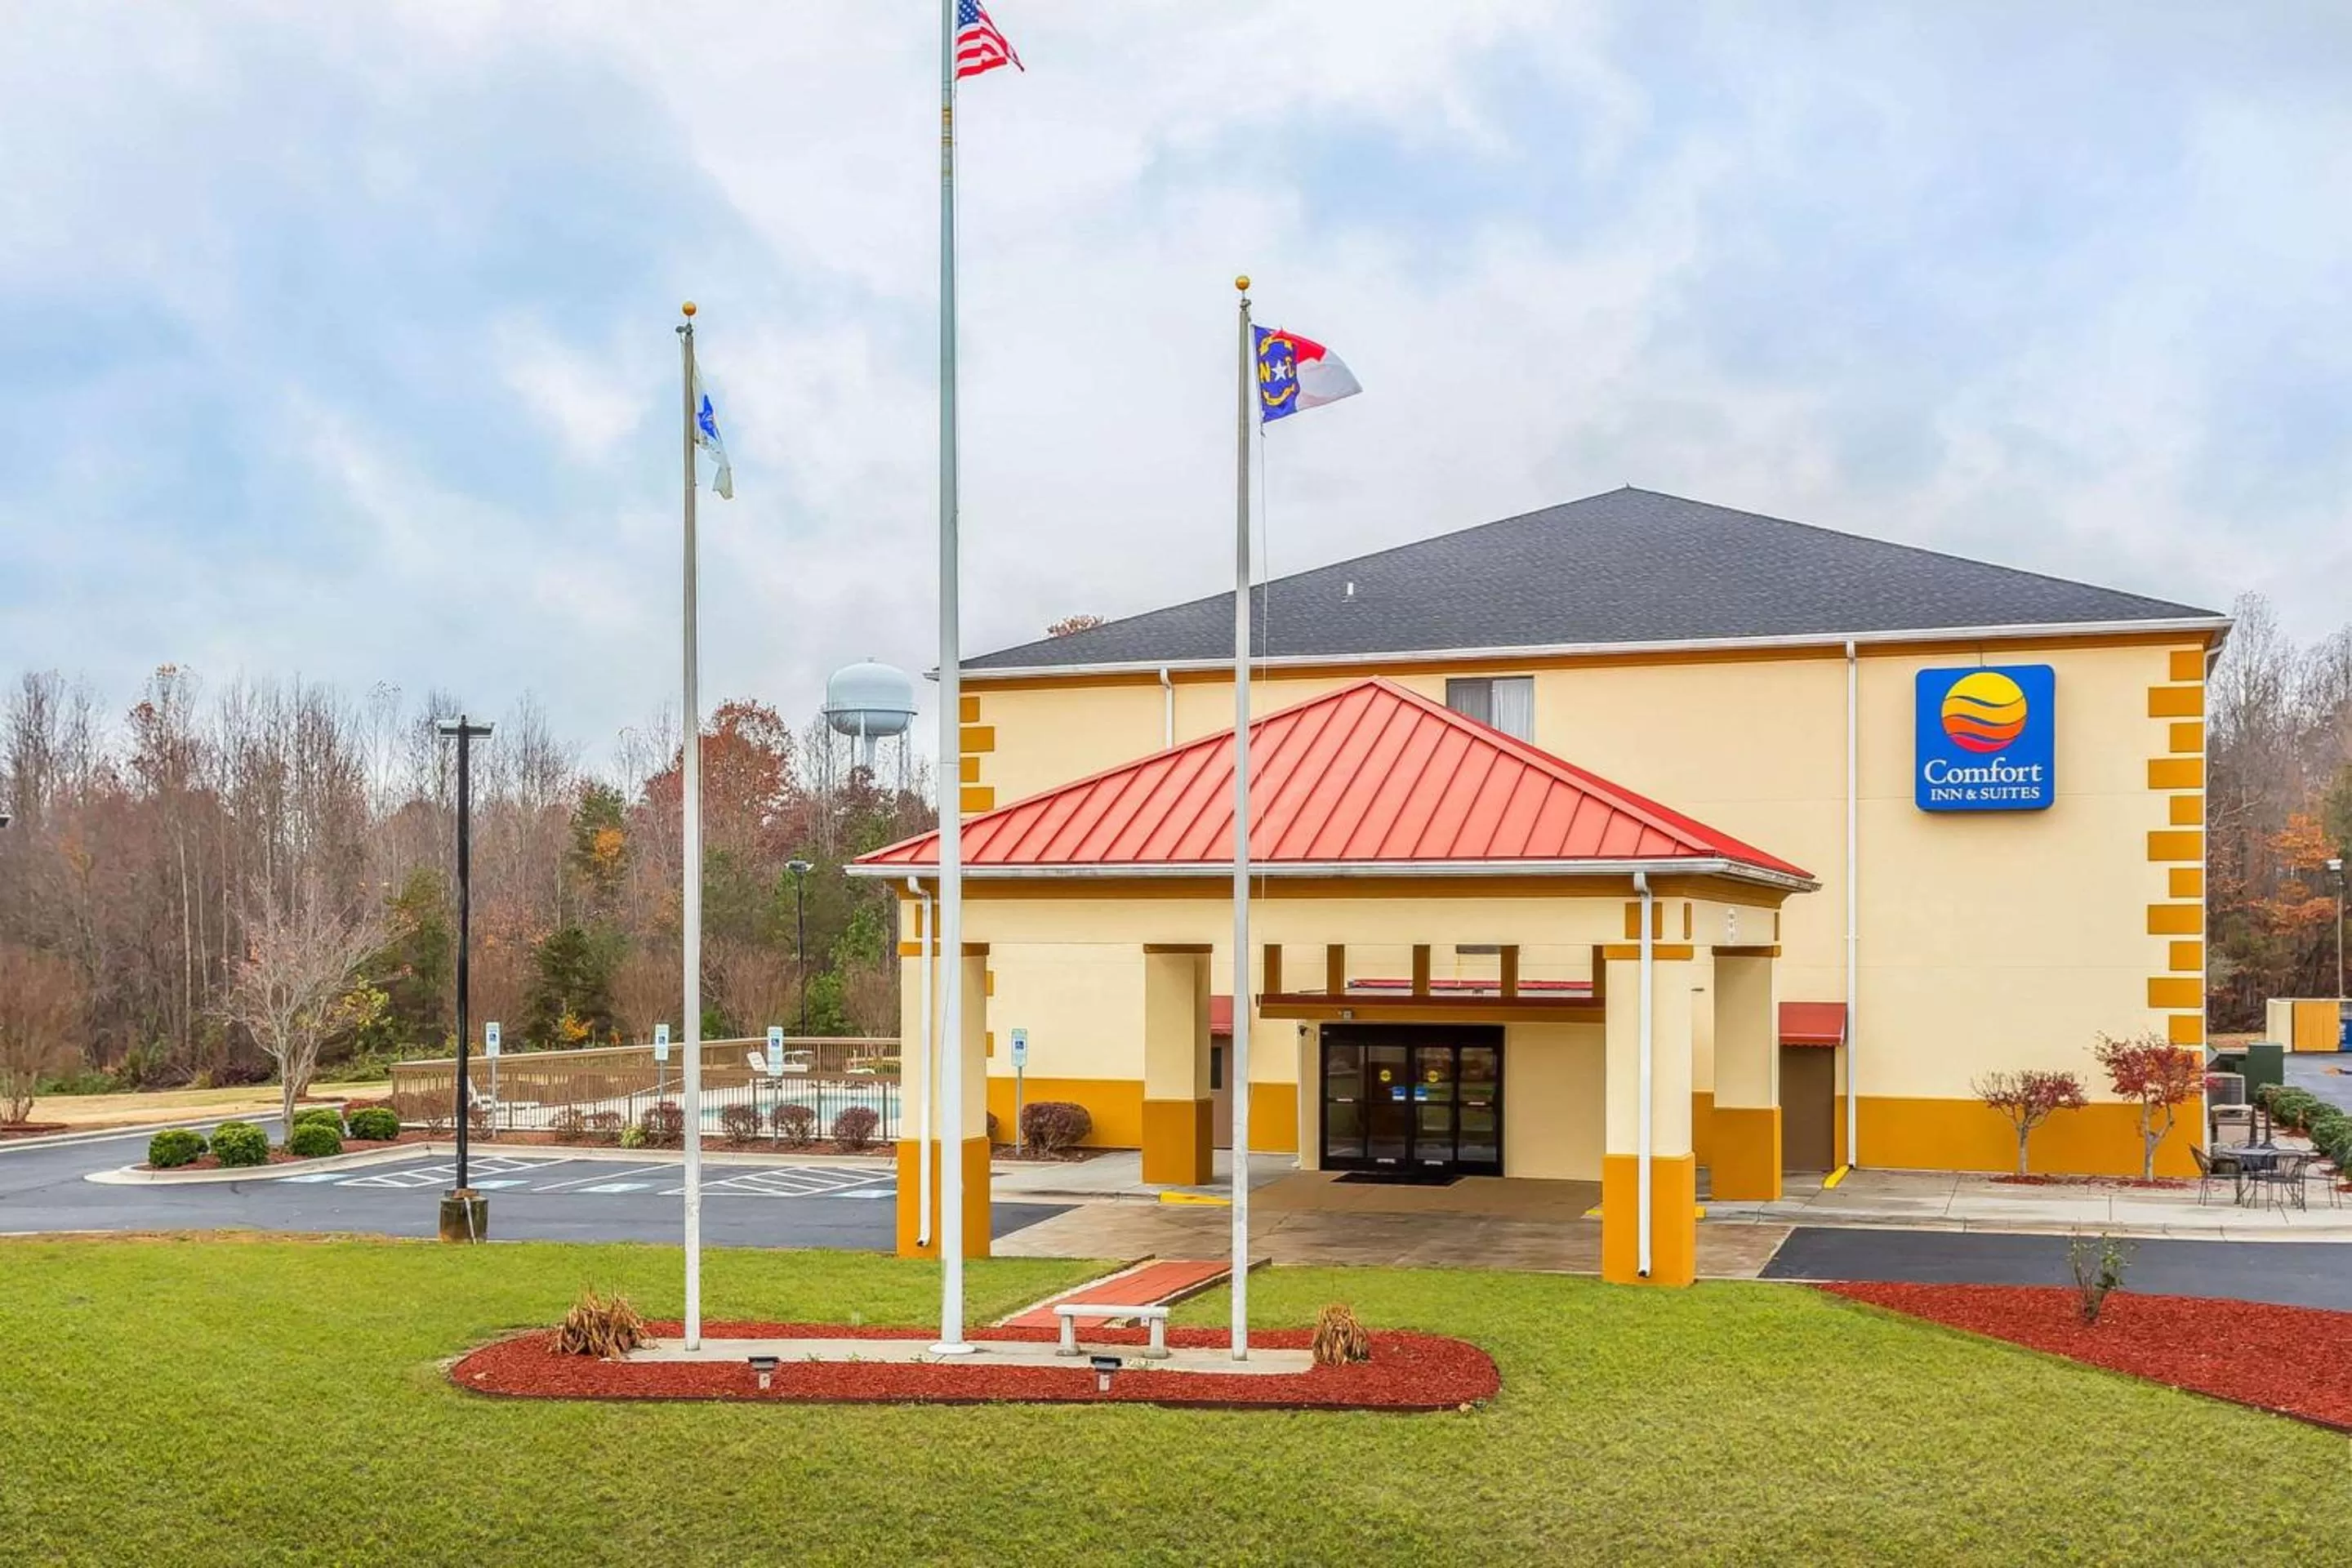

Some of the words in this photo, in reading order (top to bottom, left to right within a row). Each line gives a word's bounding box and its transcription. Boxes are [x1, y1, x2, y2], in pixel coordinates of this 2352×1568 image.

[1924, 757, 2042, 784] Comfort
[1931, 788, 1962, 800] INN
[1966, 789, 1976, 800] &
[1980, 786, 2040, 800] SUITES
